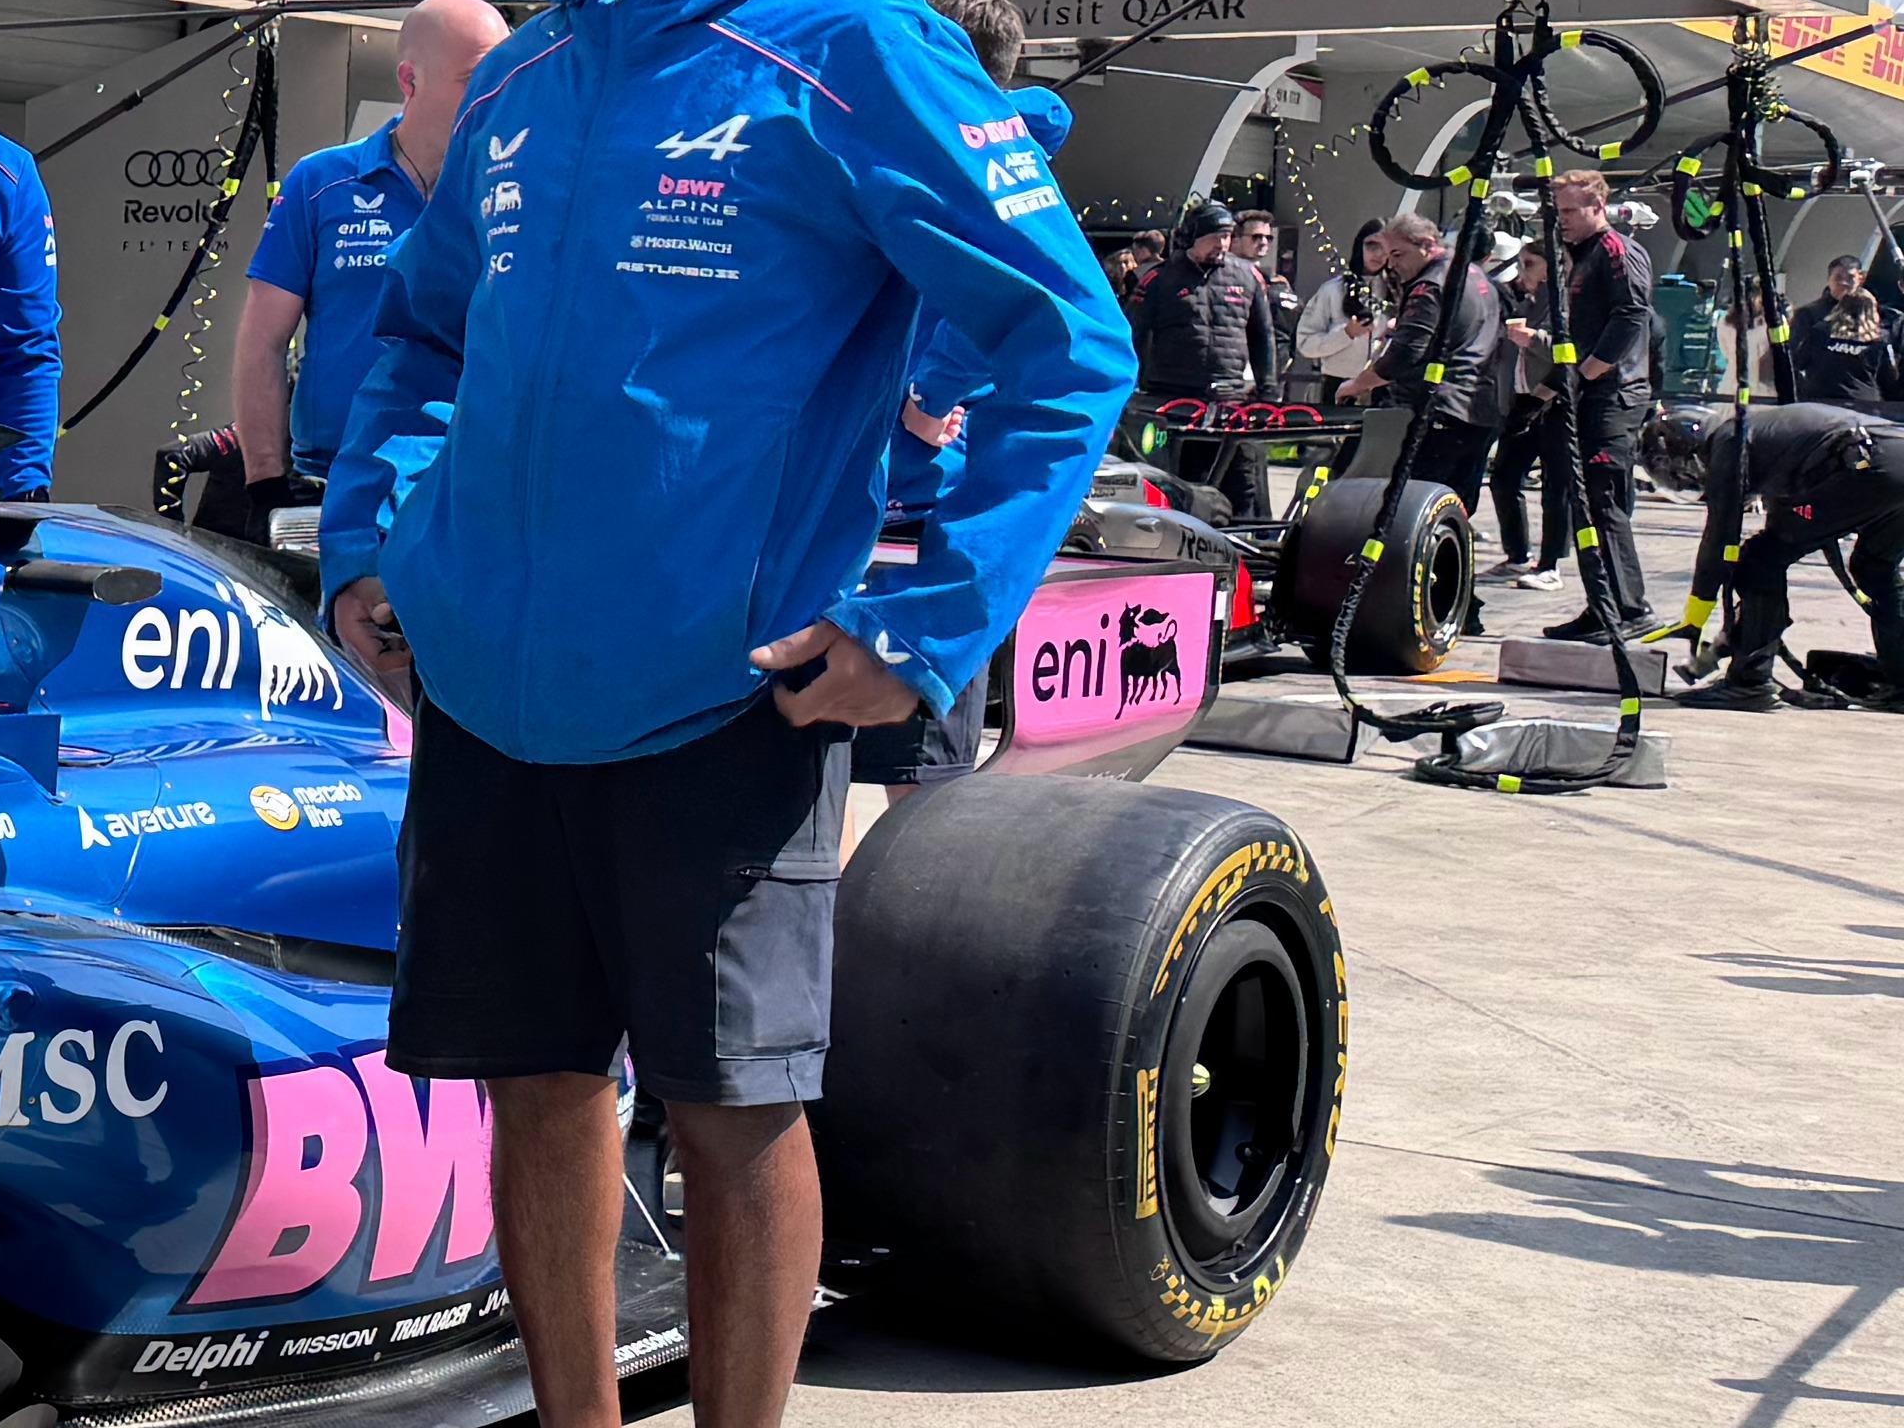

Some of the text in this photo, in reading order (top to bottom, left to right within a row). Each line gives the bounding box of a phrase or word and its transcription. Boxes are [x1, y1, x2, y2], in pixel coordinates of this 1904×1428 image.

[1023, 0, 1103, 26] visit
[675, 178, 725, 198] BWT
[639, 199, 739, 217] ALPINE
[347, 254, 387, 267] MSC
[122, 581, 241, 692] eni
[1032, 613, 1111, 702] eni
[293, 780, 362, 804] mercado
[104, 801, 216, 839] avature
[303, 805, 344, 828] libre
[133, 1330, 270, 1377] Delphi
[280, 1327, 379, 1357] MISSION
[427, 1302, 472, 1333] RACER
